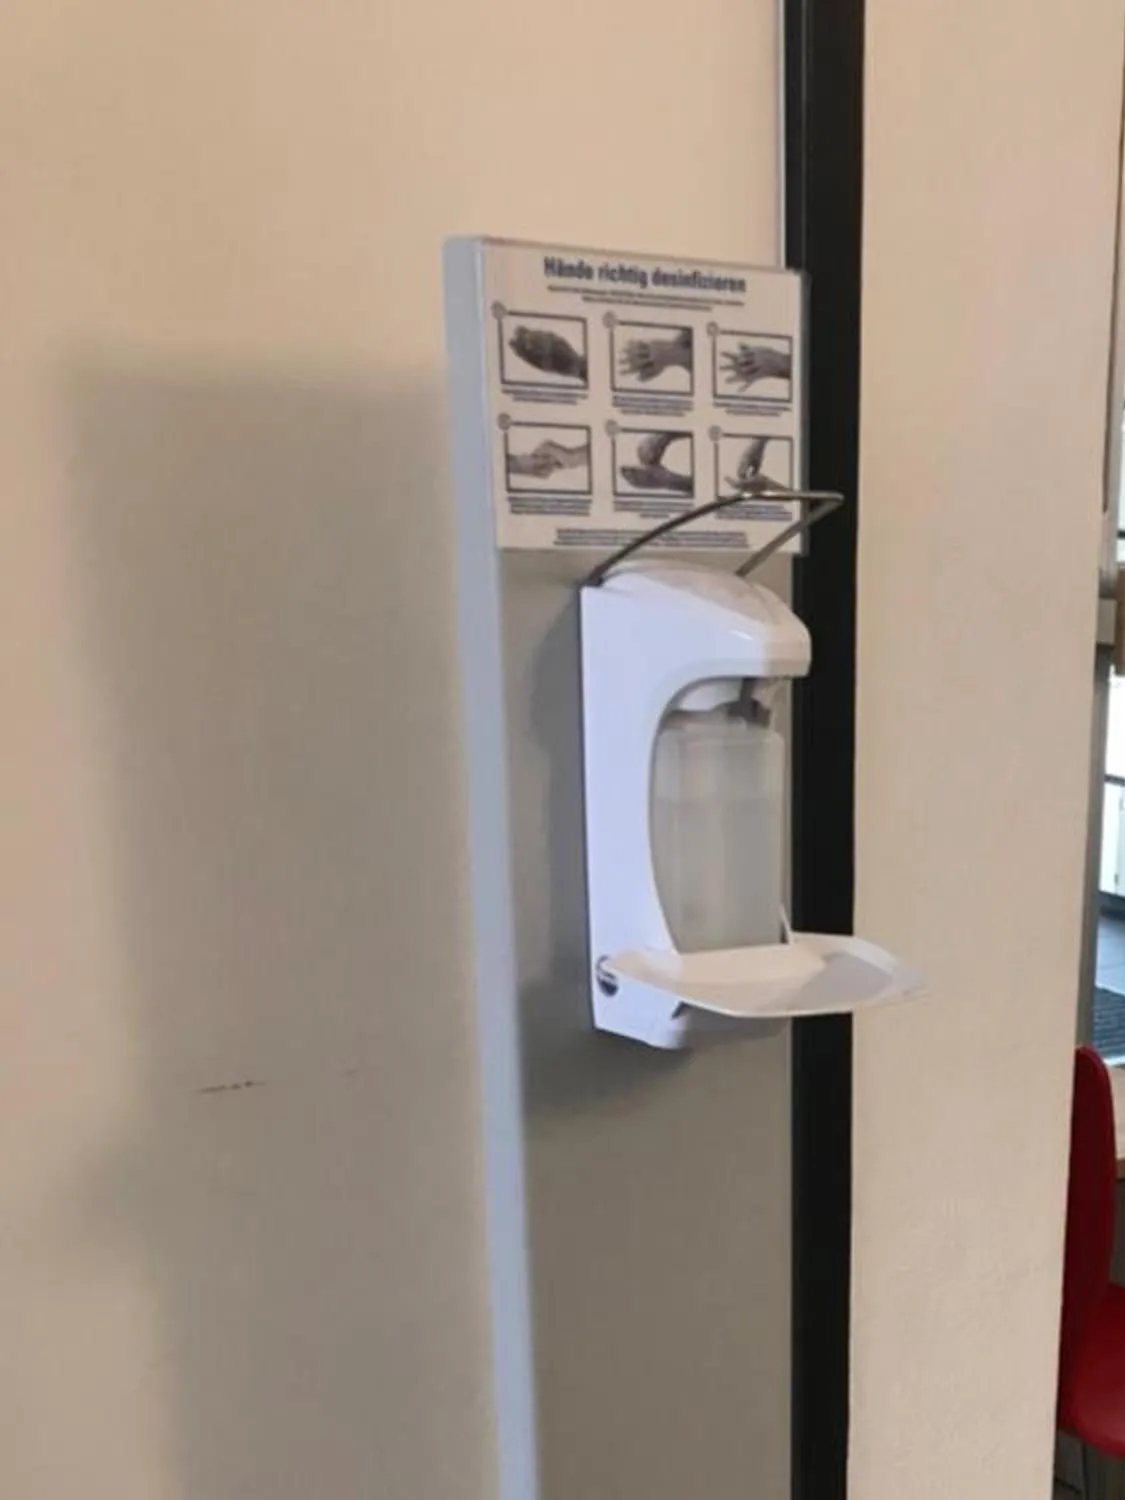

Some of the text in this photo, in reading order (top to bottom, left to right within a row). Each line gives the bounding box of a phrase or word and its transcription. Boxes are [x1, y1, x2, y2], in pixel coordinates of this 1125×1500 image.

[544, 256, 746, 293] Hände richtig desinfizieren
